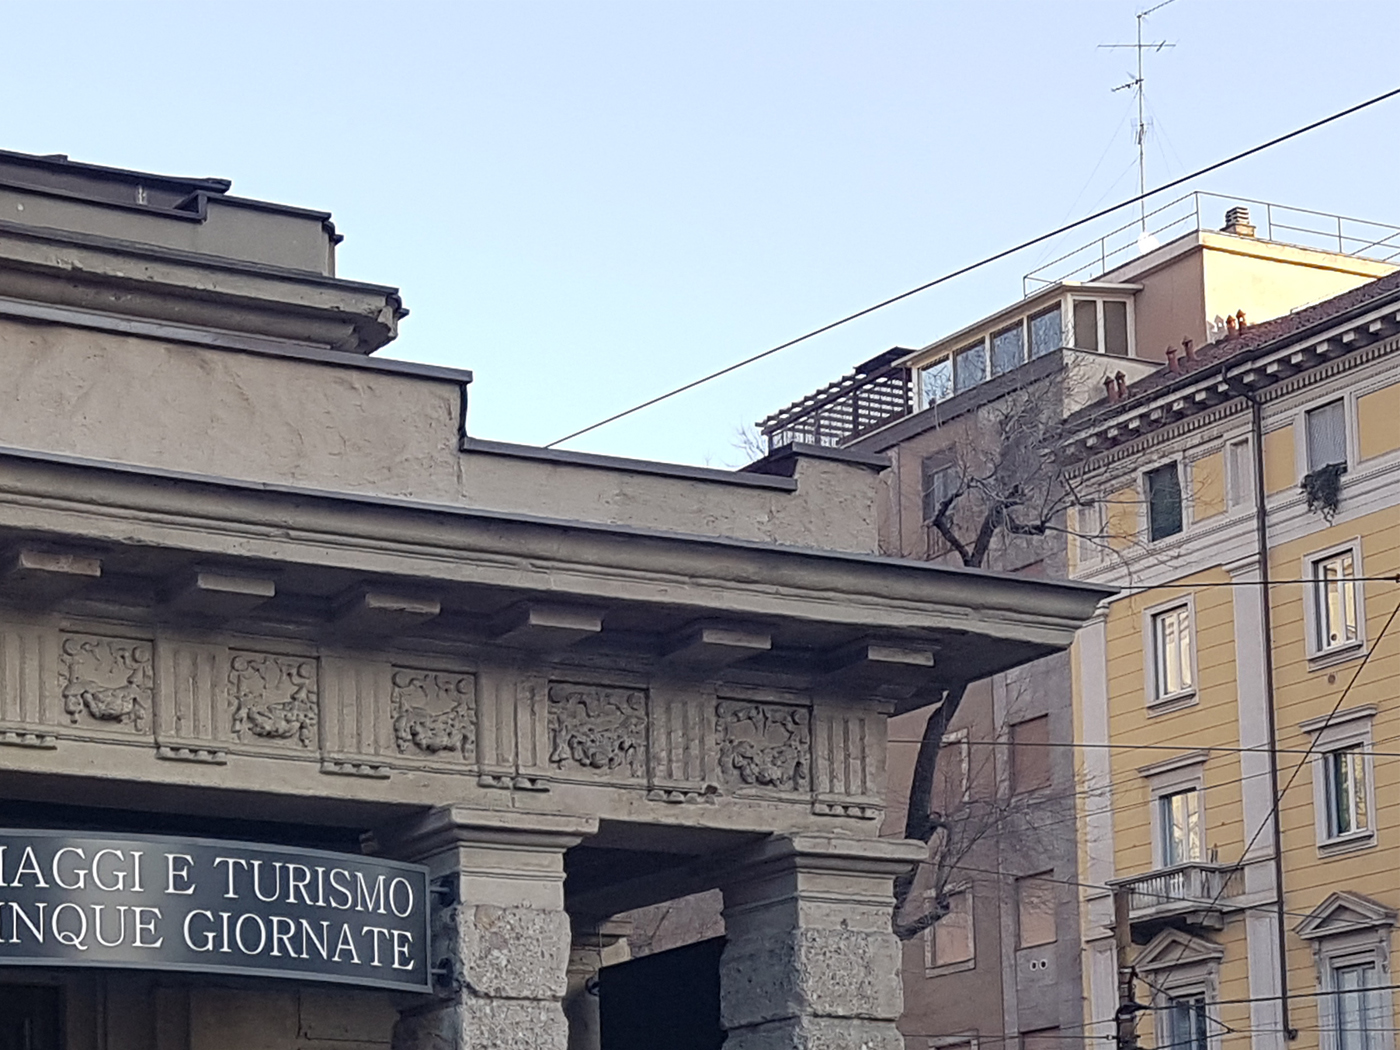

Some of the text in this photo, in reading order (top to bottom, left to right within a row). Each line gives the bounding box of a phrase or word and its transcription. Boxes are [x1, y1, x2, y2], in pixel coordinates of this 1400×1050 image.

[164, 853, 196, 894] E
[214, 857, 414, 918] TURISMO
[183, 909, 415, 971] GIORNATE
